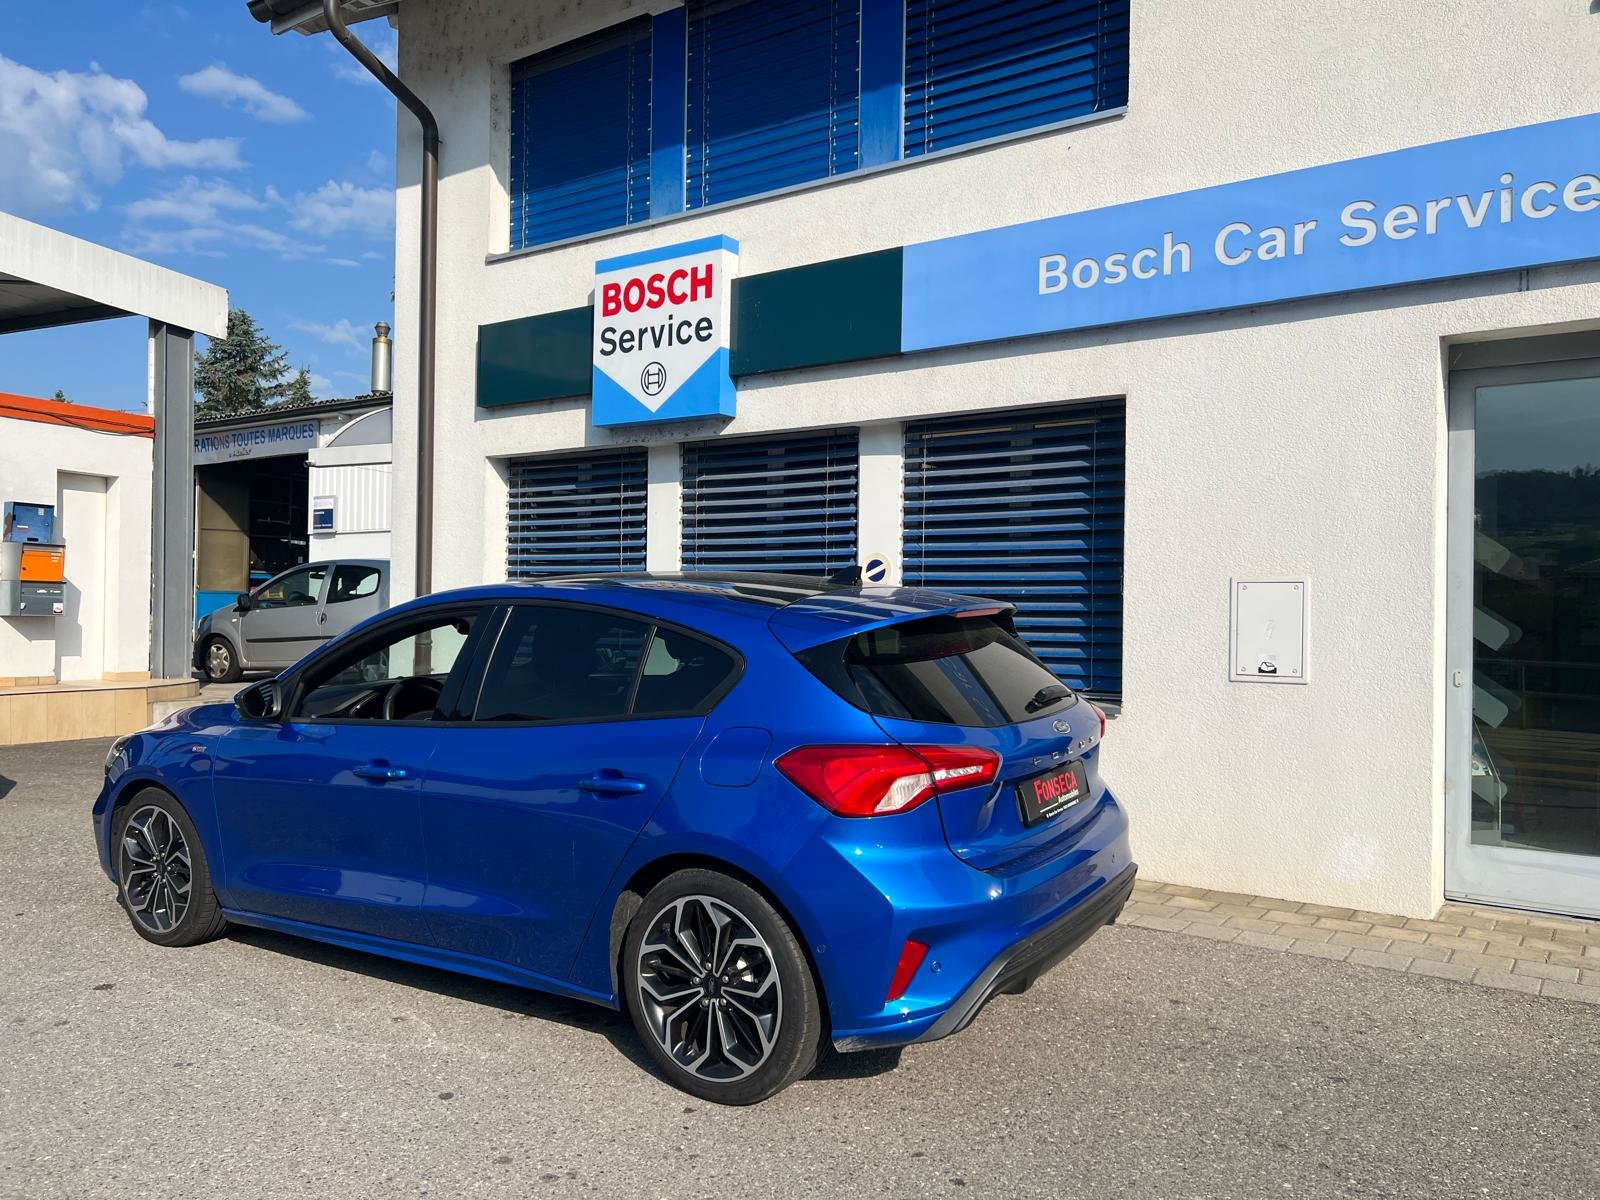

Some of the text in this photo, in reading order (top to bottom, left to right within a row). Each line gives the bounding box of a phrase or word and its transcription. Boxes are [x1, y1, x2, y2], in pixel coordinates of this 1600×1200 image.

[1037, 172, 1600, 296] Bosch Car Service
[602, 264, 713, 317] BOSCH
[599, 313, 714, 357] Service
[231, 429, 267, 448] TOUTES
[268, 423, 314, 443] MARQUES
[1033, 769, 1078, 804] FONSECA
